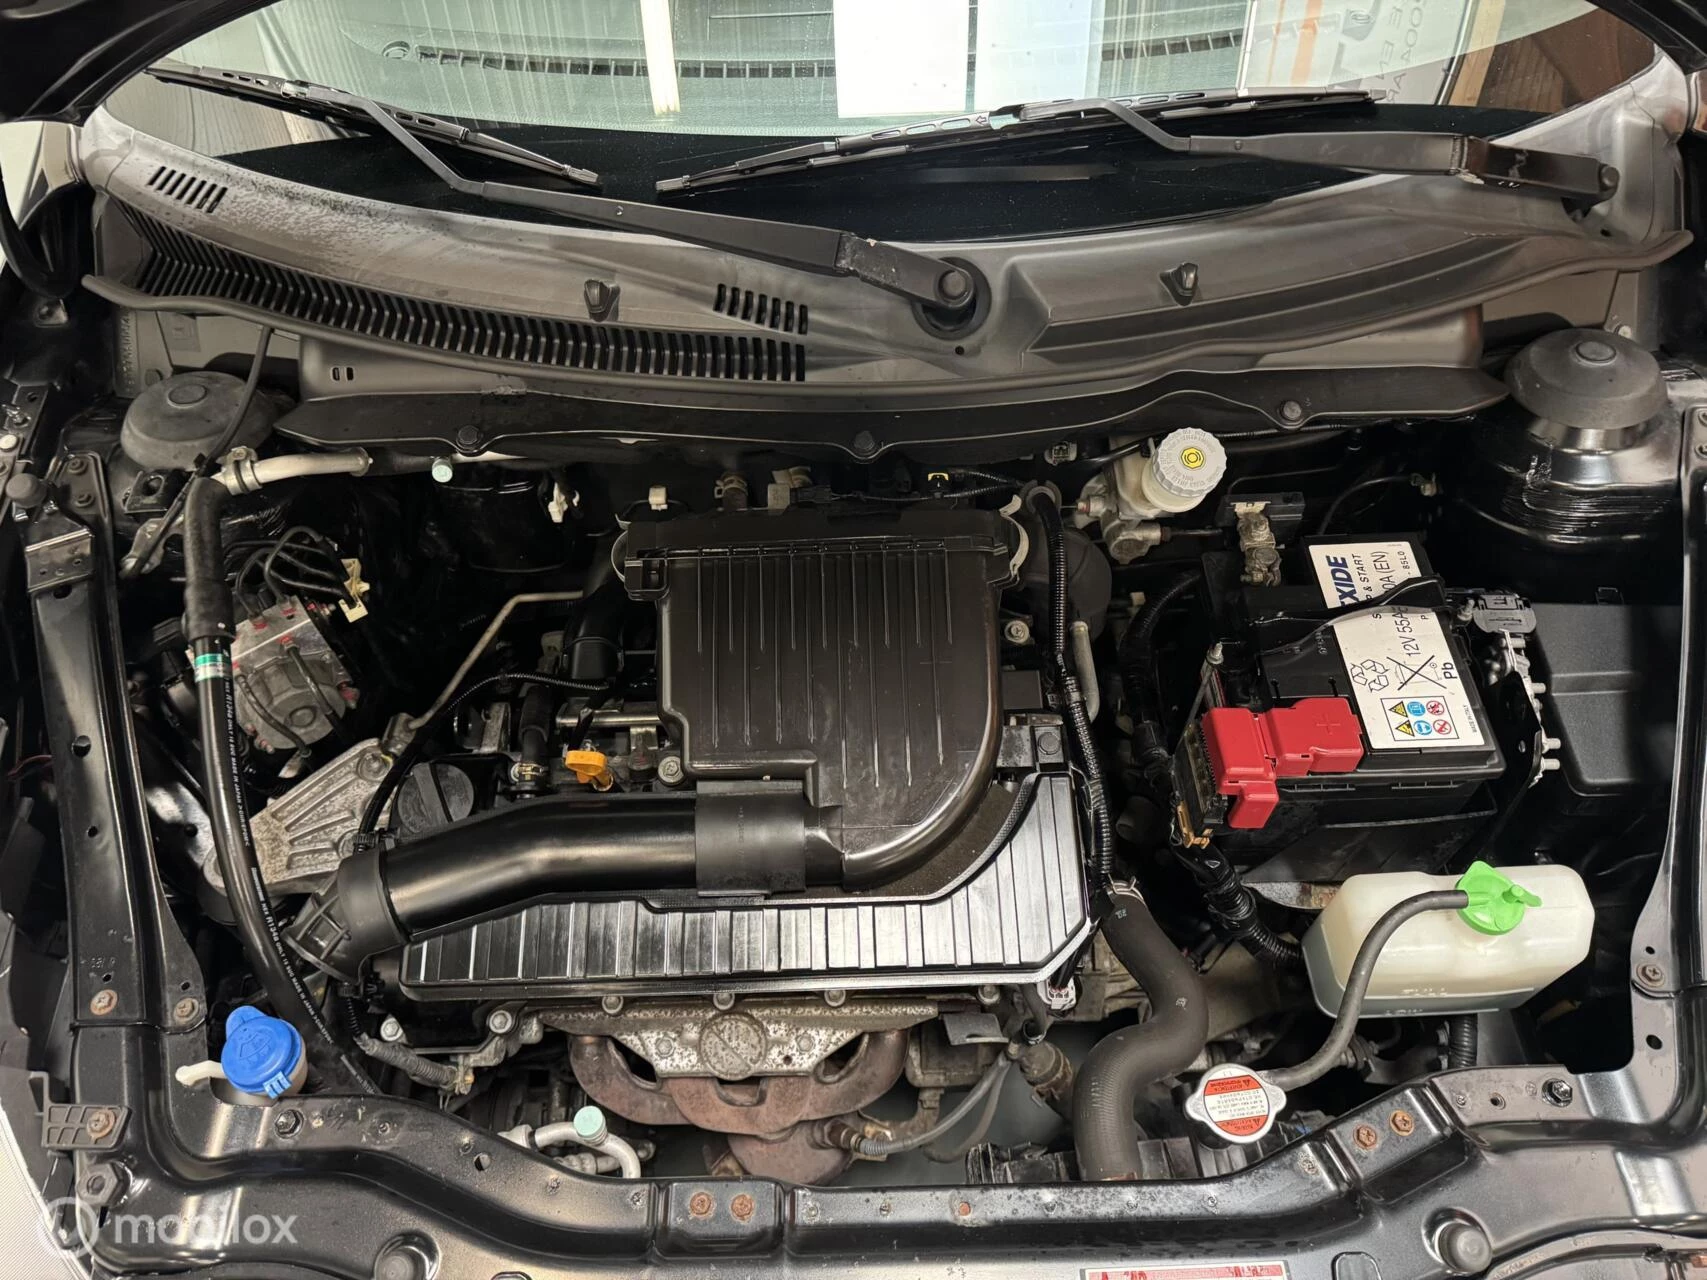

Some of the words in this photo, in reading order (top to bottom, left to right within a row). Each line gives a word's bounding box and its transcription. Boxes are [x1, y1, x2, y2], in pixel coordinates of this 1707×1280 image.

[1352, 553, 1370, 584] START
[1399, 635, 1421, 657] 12V
[1441, 662, 1459, 681] Pb
[234, 783, 242, 803] JAPAN
